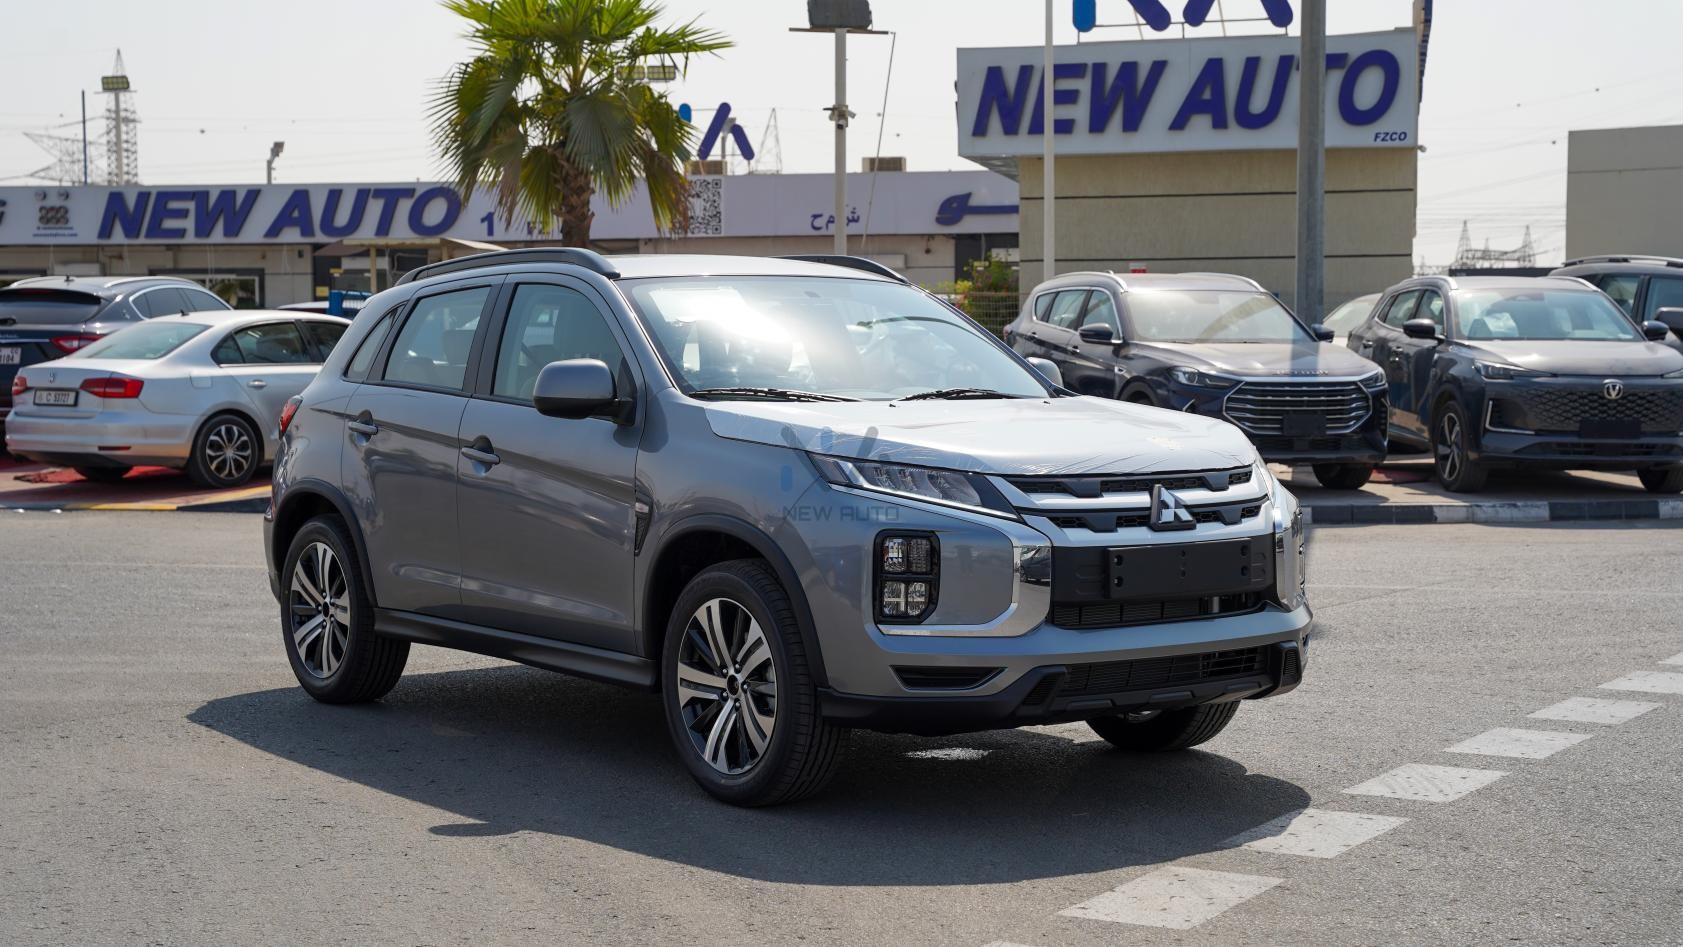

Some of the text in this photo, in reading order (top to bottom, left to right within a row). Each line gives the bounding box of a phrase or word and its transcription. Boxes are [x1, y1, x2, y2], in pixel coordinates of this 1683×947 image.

[972, 60, 1168, 137] NEW
[1374, 131, 1408, 142] FZCO
[98, 189, 261, 239] NEW
[264, 187, 462, 238] AUTO
